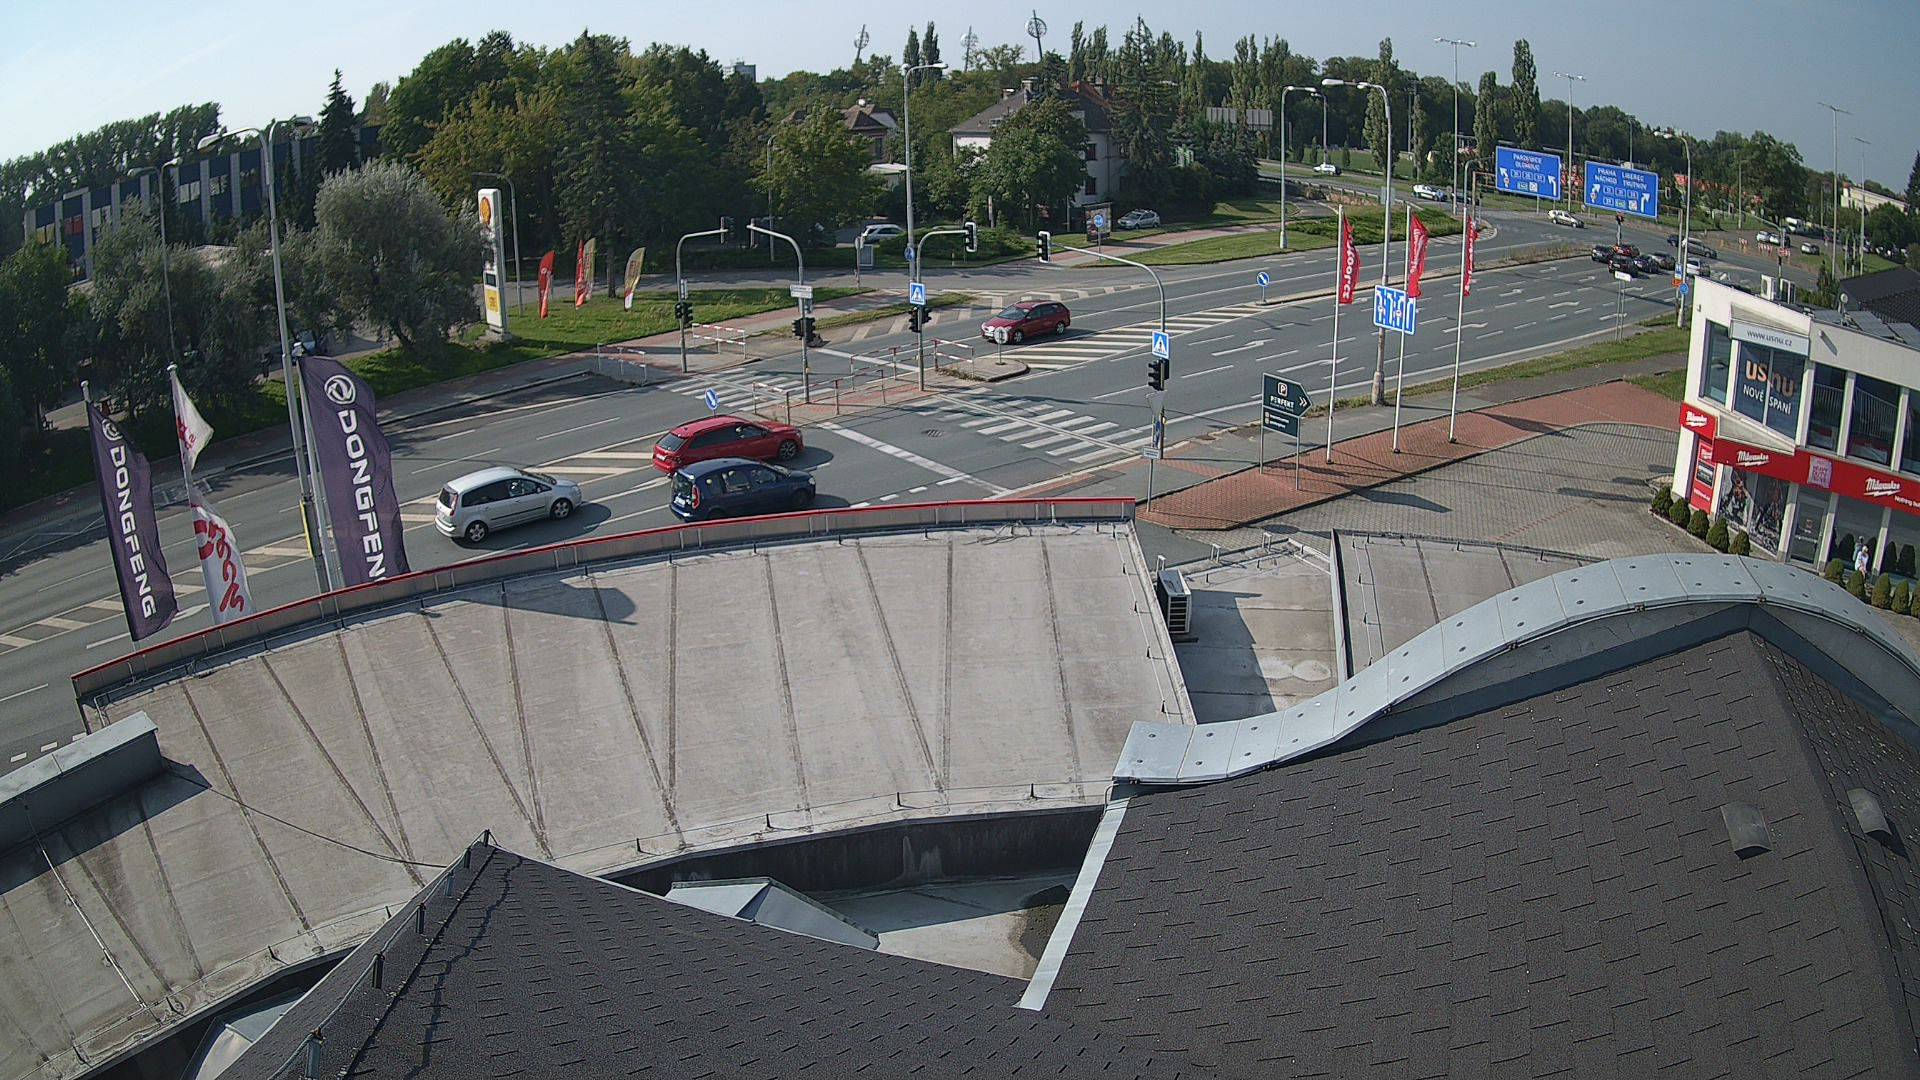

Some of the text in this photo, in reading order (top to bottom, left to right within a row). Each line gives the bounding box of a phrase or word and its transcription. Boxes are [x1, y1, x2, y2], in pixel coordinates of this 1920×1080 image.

[1746, 329, 1793, 347] www.usnu.cz
[1743, 384, 1792, 415] NOVÉ SPANÍ
[336, 409, 387, 582] DONGFEN
[1865, 477, 1901, 492] Milwaukee
[109, 446, 158, 619] DONGFENG
